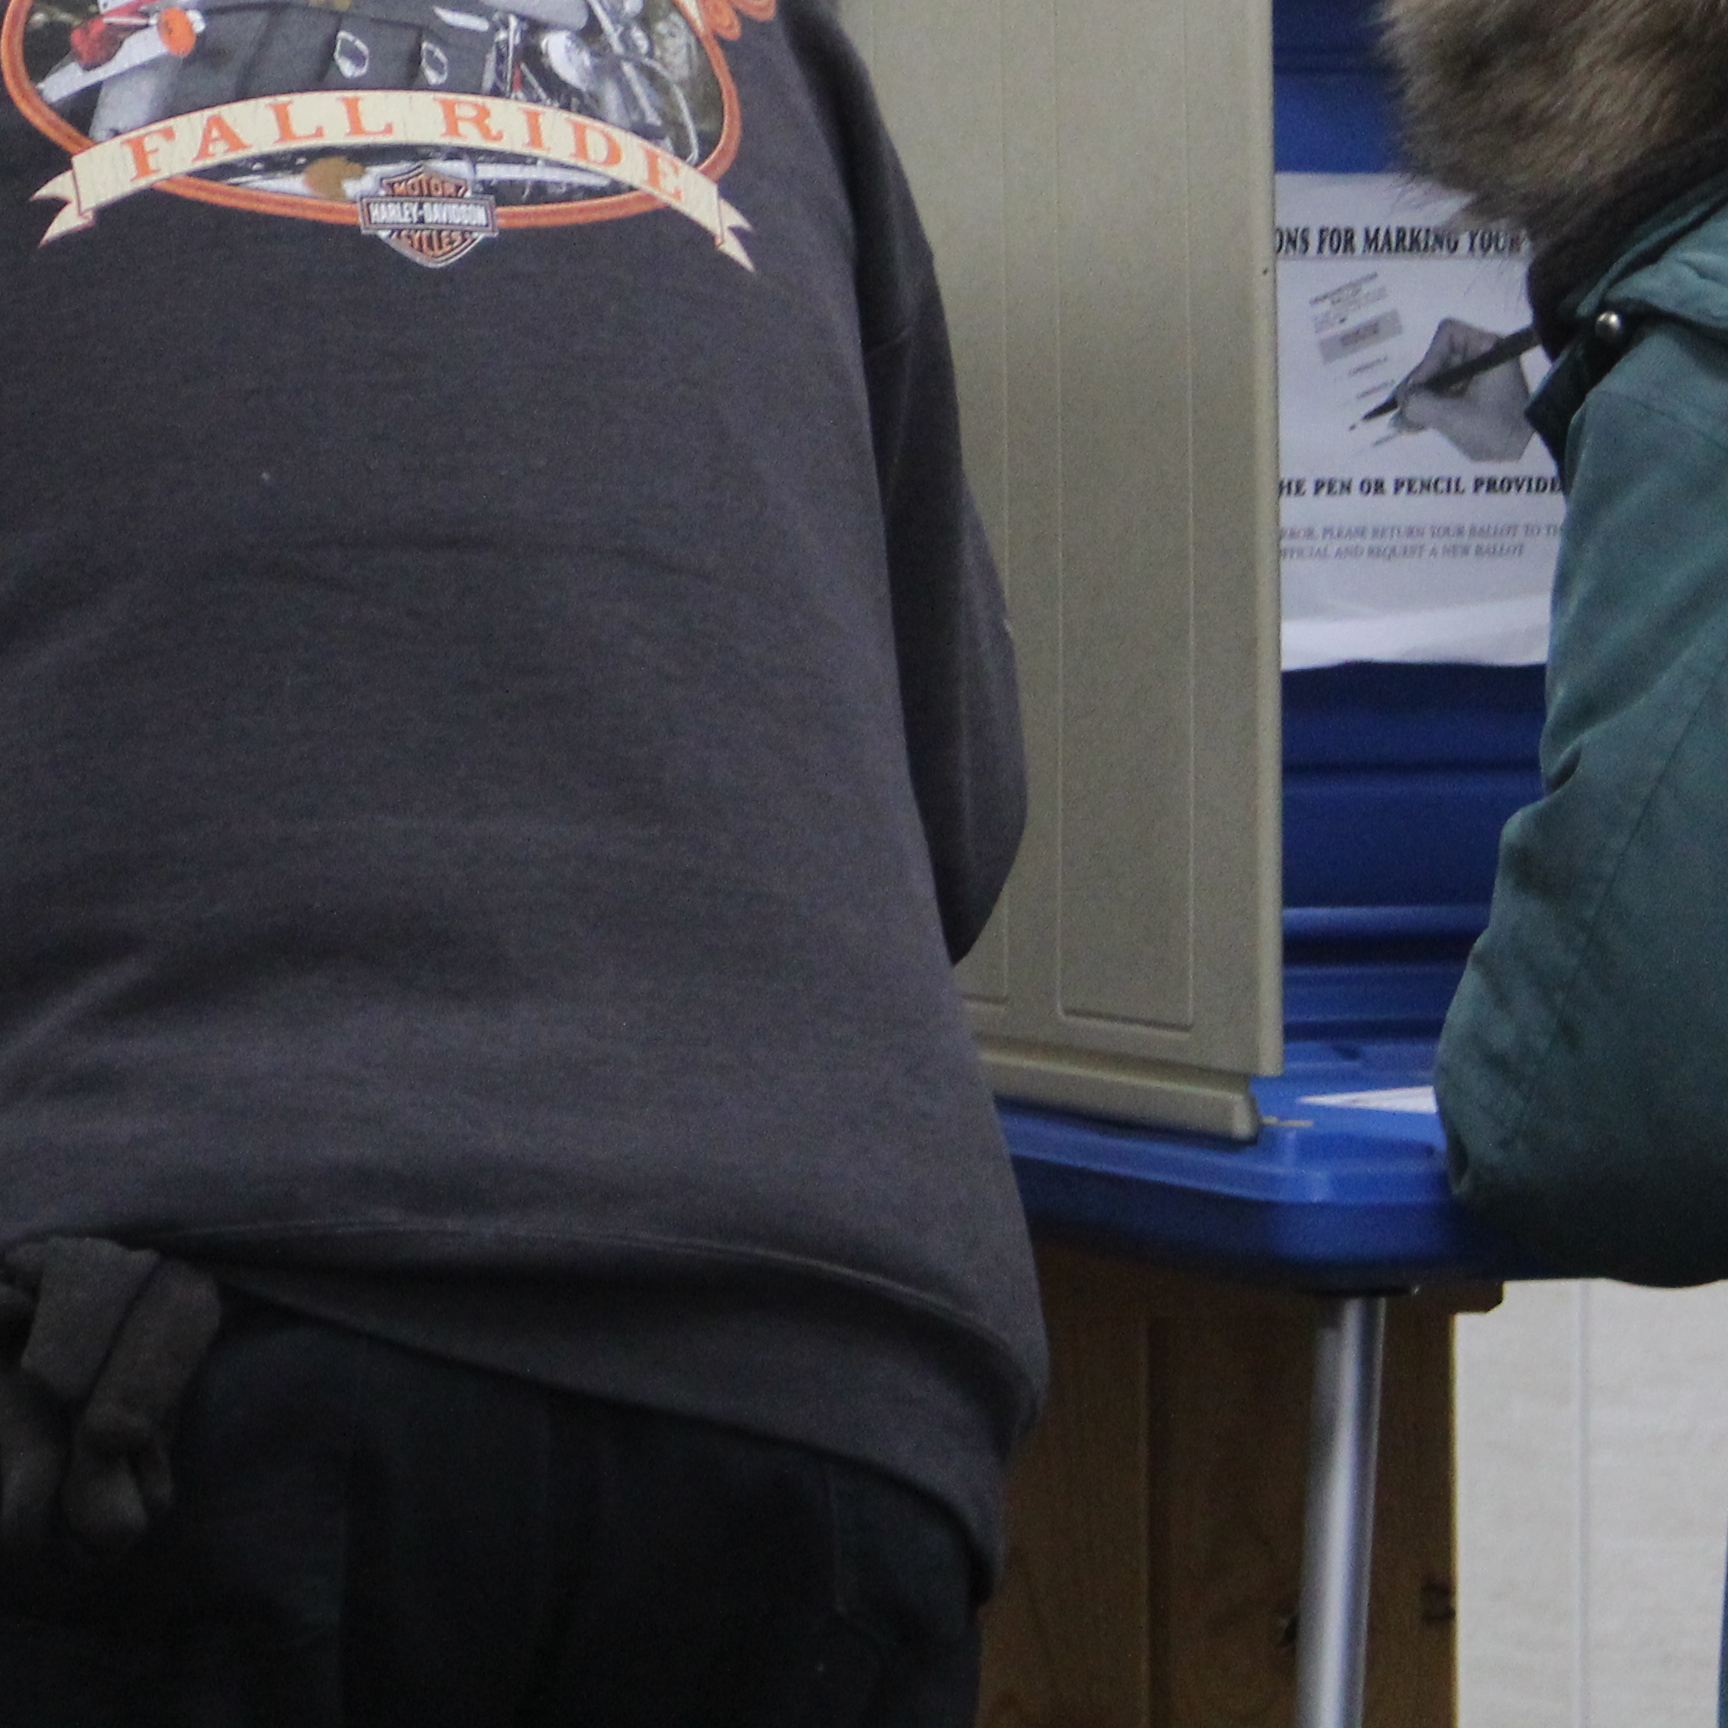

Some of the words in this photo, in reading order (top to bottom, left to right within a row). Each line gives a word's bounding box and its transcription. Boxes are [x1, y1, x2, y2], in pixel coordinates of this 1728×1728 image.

[128, 96, 396, 184] FALL
[441, 94, 693, 202] RIDE
[1317, 226, 1355, 255] FOR
[1313, 478, 1353, 496] PEN
[1359, 478, 1386, 496] OR
[1394, 476, 1465, 496] PENCIL
